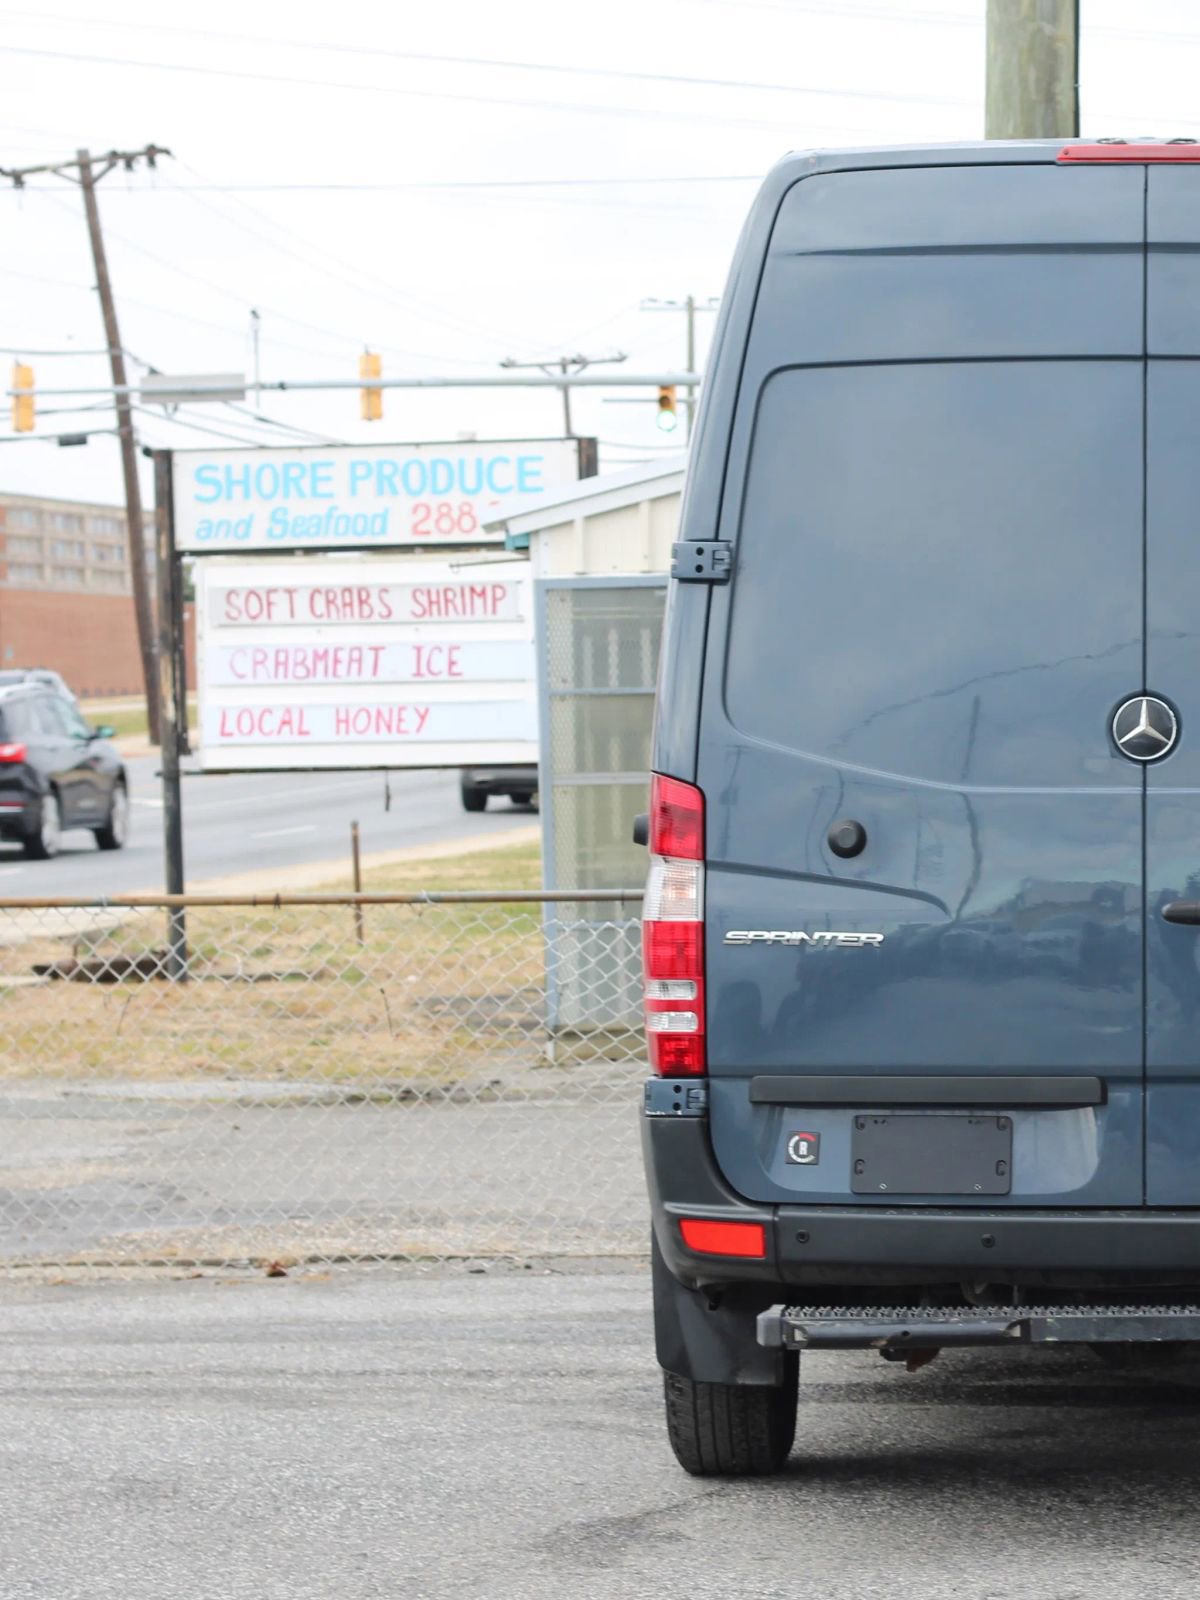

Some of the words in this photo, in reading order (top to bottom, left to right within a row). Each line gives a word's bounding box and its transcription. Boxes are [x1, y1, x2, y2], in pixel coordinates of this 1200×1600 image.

[193, 460, 336, 503] SHORE
[349, 455, 545, 496] PRODUCE
[195, 514, 254, 541] and
[266, 505, 390, 538] Seafood
[411, 500, 500, 536] 288
[224, 589, 297, 621] SOFT
[309, 586, 393, 619] CRABS
[411, 584, 507, 619] SHRIMP
[229, 645, 386, 680] CRABMEAT
[411, 644, 463, 678] ICE
[219, 706, 311, 738] LOCAL
[335, 705, 431, 737] HONEY
[723, 930, 884, 947] SPRINTER
